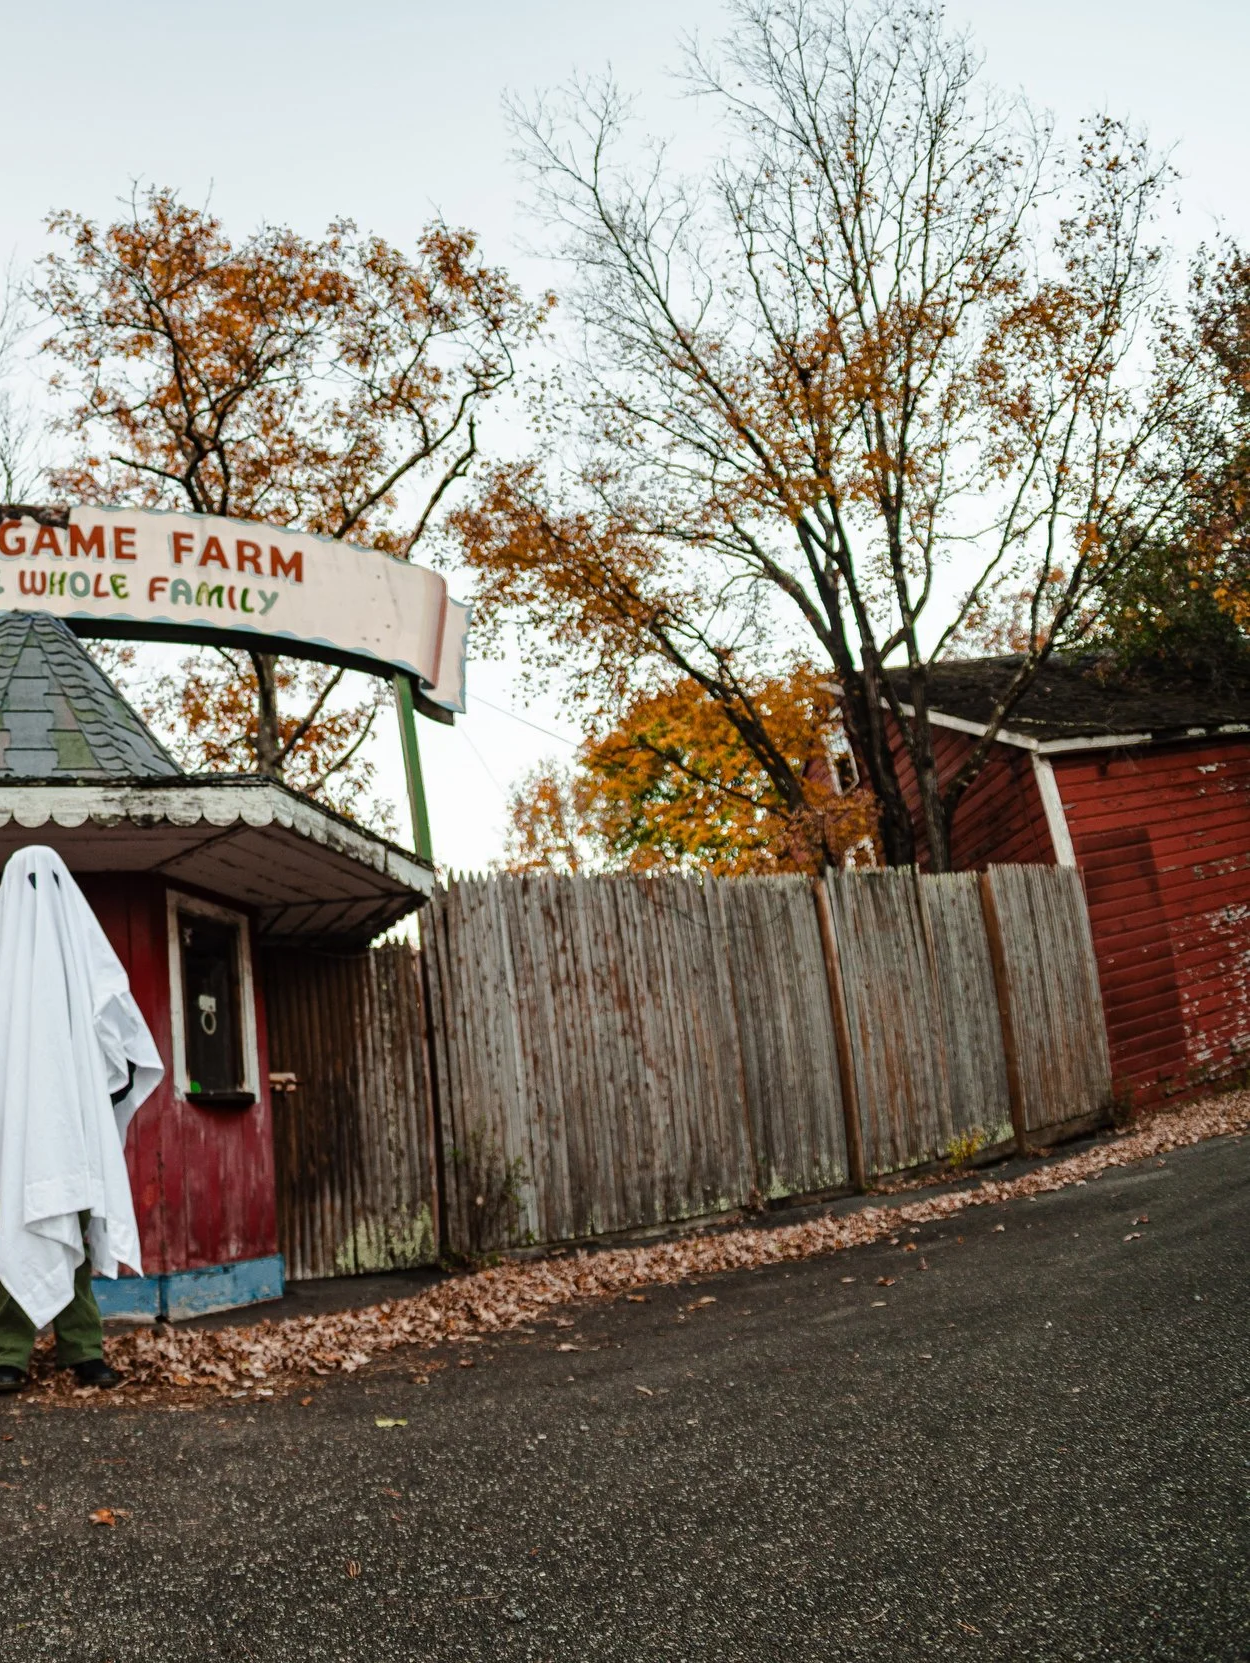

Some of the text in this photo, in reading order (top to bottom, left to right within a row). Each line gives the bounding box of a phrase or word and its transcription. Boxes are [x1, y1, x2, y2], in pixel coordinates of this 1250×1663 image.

[171, 531, 304, 583] FARM
[18, 570, 130, 599] WHOLE
[148, 576, 280, 615] FAMILY
